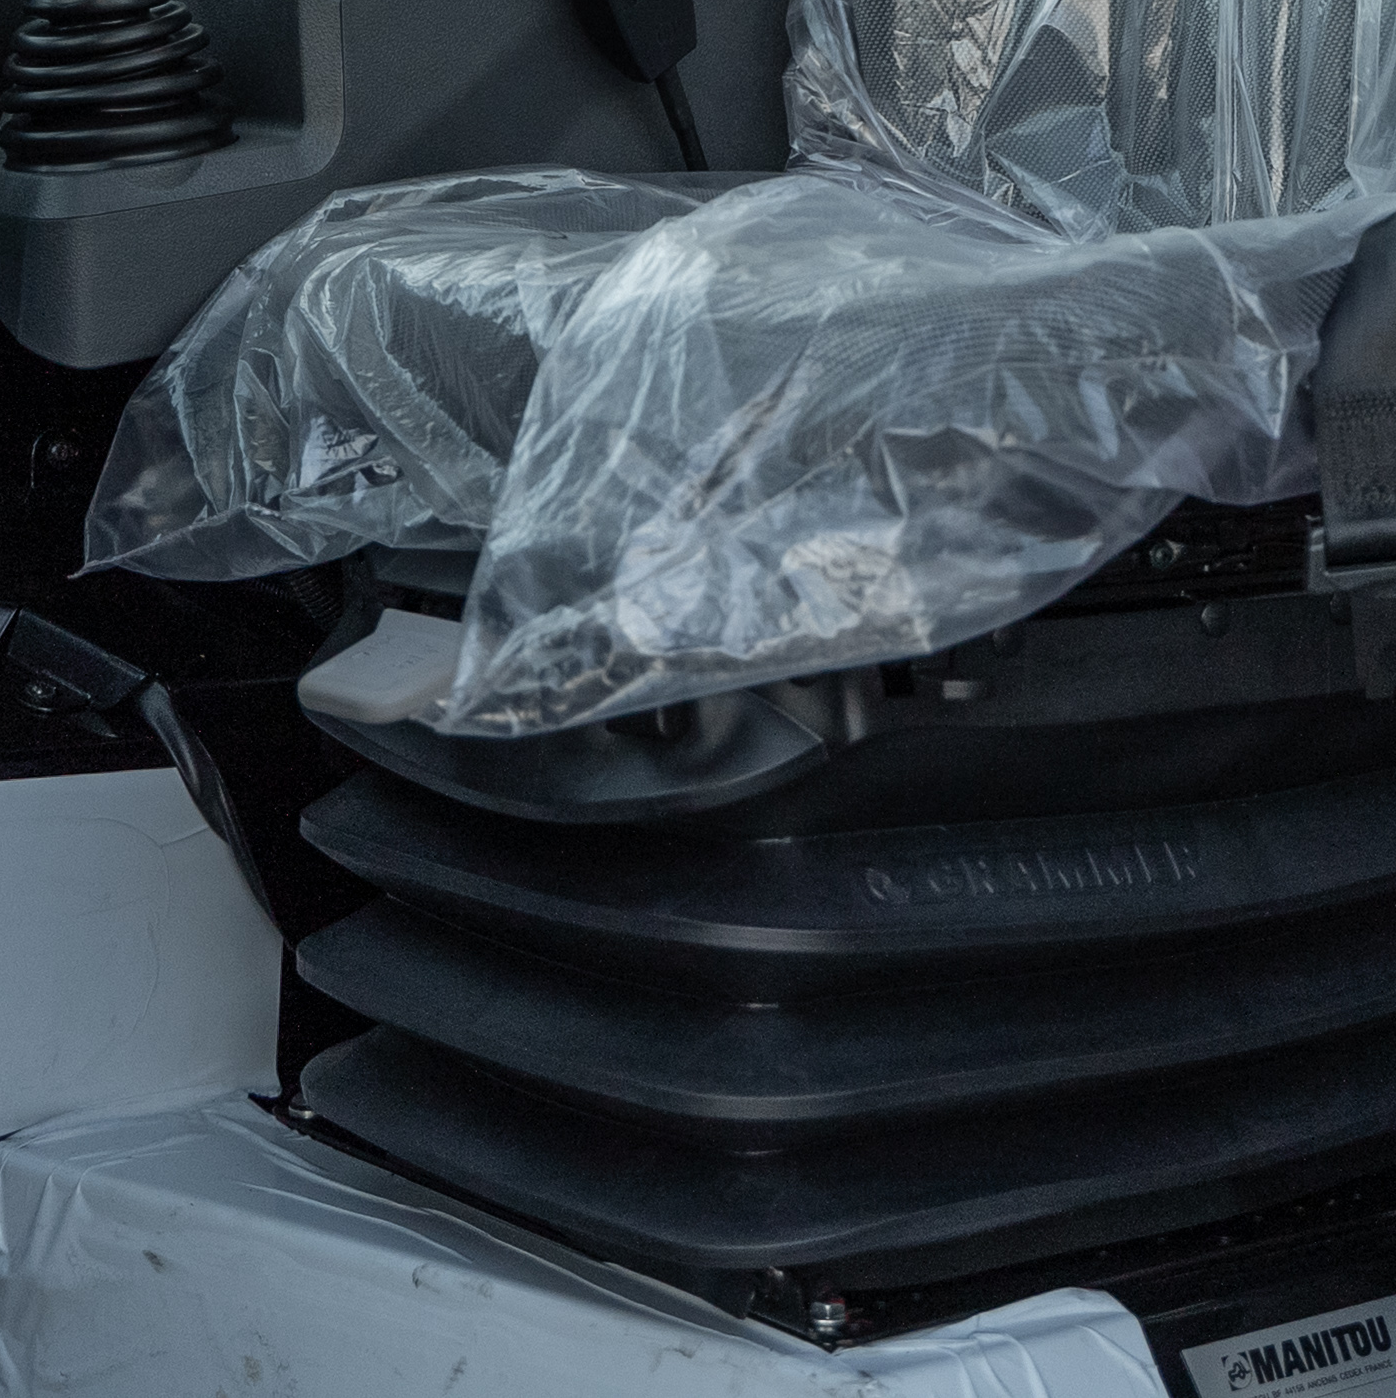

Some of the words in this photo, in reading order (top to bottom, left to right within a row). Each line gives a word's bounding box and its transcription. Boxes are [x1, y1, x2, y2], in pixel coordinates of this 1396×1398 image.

[1248, 1315, 1392, 1385] MANITOU
[1307, 1375, 1339, 1390] ANCENIS
[1339, 1368, 1364, 1380] CEDEX
[1365, 1359, 1393, 1374] FRANCE
